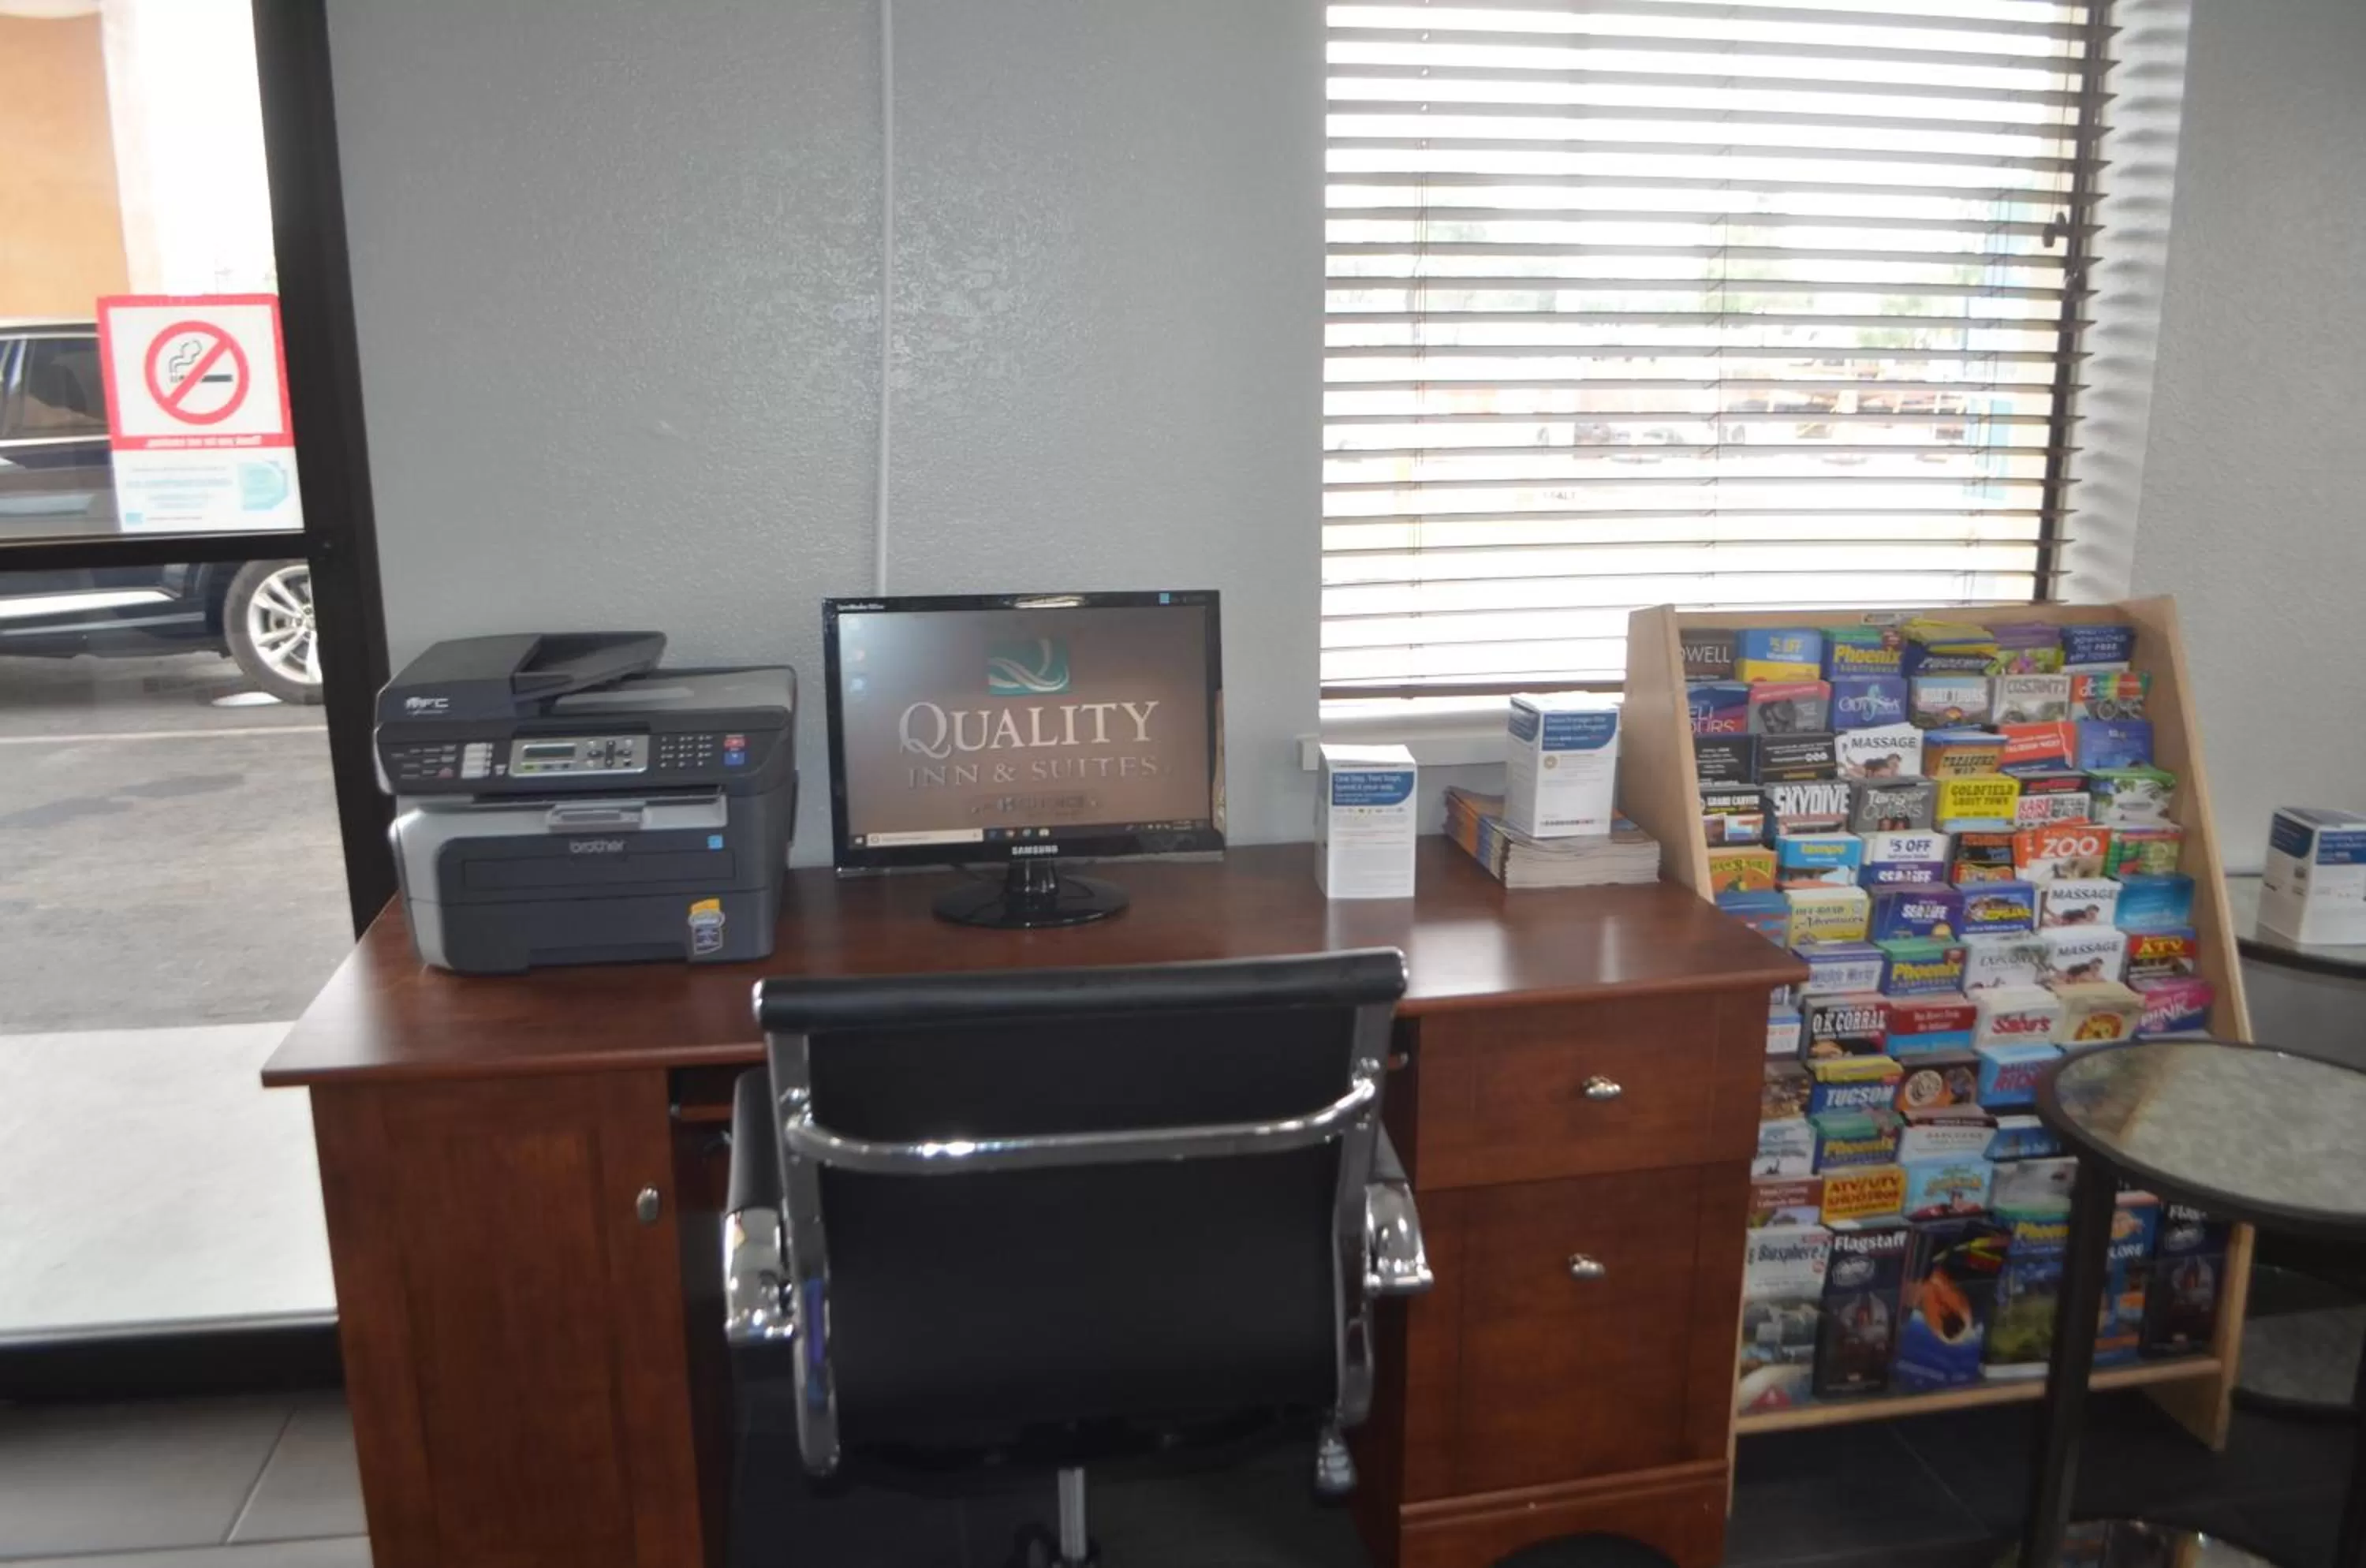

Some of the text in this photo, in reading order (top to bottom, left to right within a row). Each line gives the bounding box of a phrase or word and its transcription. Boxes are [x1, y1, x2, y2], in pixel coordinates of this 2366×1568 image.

[1833, 644, 1902, 664] Phoenix
[898, 700, 1159, 760] QUALITY
[1851, 737, 1918, 749] MASSAGE
[908, 754, 1159, 789] INN & SUITES
[1774, 784, 1851, 816] SKYDIVE
[1951, 785, 2015, 797] GOLDFIELD
[569, 839, 625, 853] brother
[1011, 846, 1058, 856] SAMSUNG
[1905, 839, 1931, 853] OFF
[2041, 835, 2099, 858] ZOO
[2051, 888, 2115, 901] MASSAGE
[2057, 943, 2119, 957] MASSAGE
[2138, 938, 2185, 956] ATV
[1893, 962, 1961, 980] Phoenix
[1835, 1010, 1887, 1031] CORRAL
[1826, 1085, 1896, 1107] TUCSON
[1834, 1230, 1908, 1252] Flagstaff
